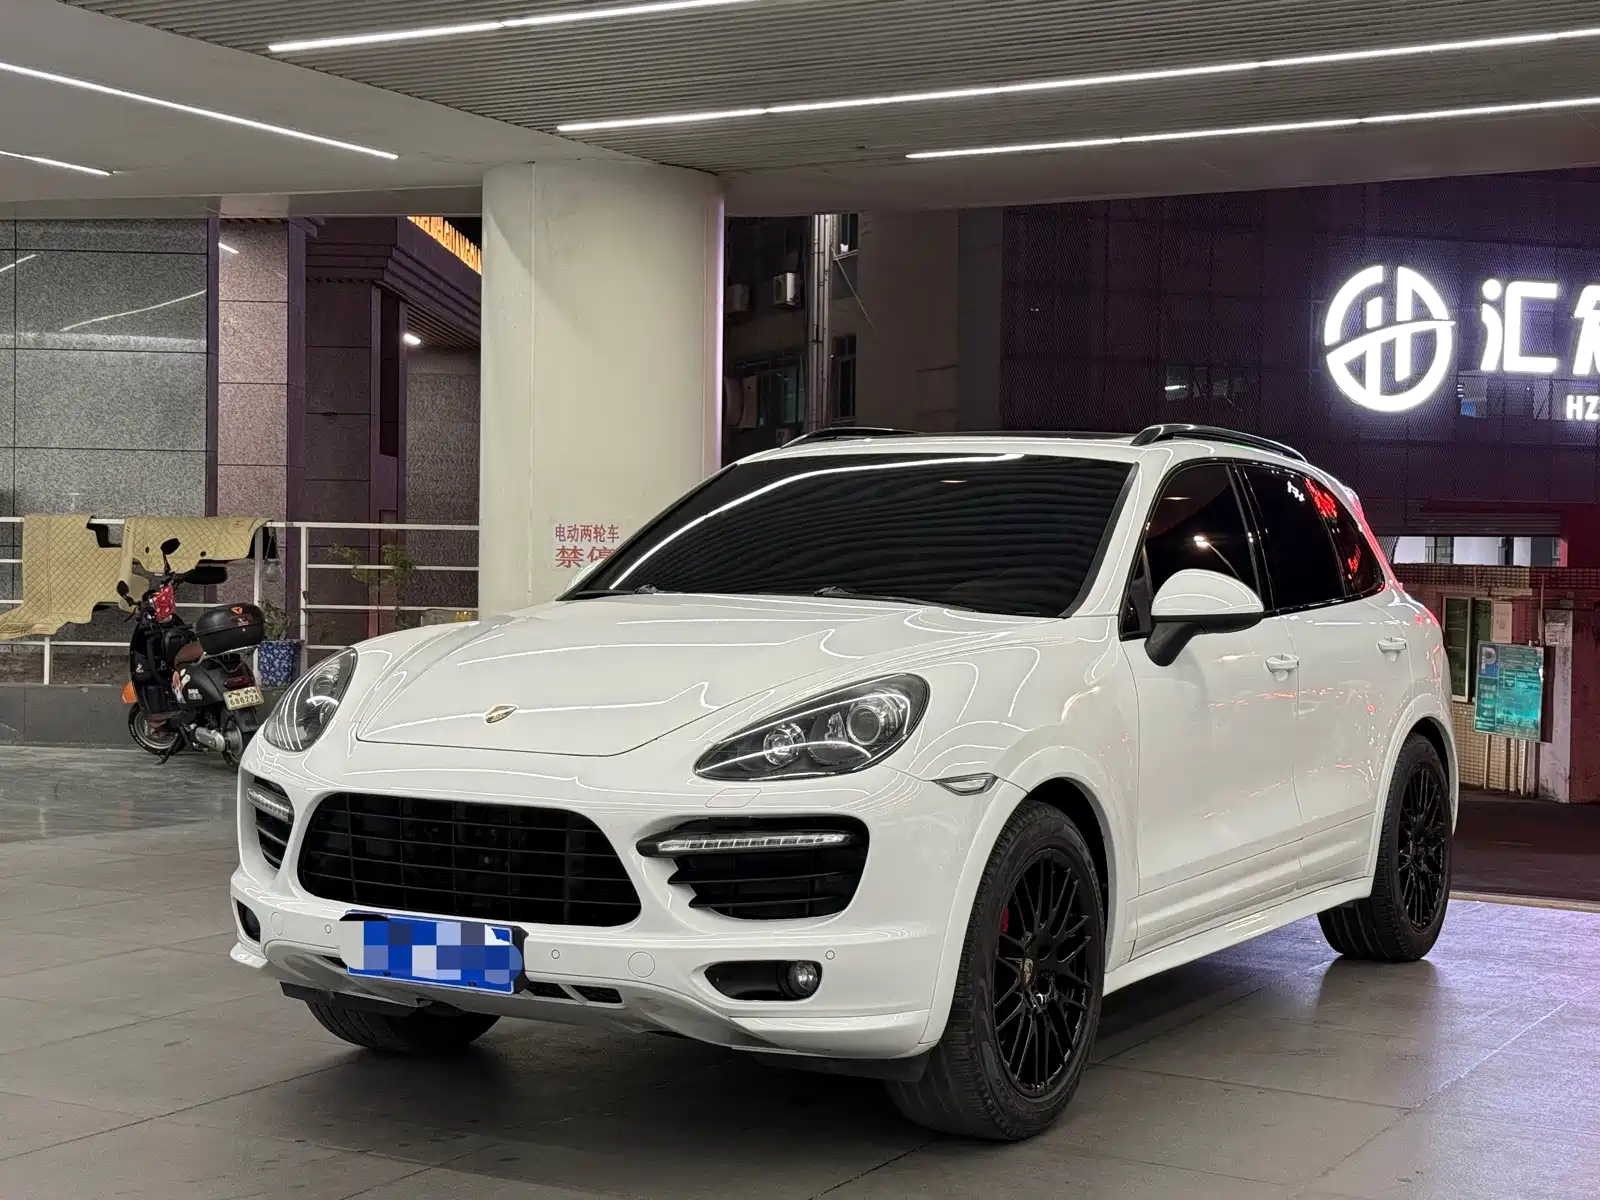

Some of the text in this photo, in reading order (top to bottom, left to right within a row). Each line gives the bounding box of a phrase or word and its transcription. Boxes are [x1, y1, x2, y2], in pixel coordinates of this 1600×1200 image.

[555, 523, 620, 543] 电动两轮车
